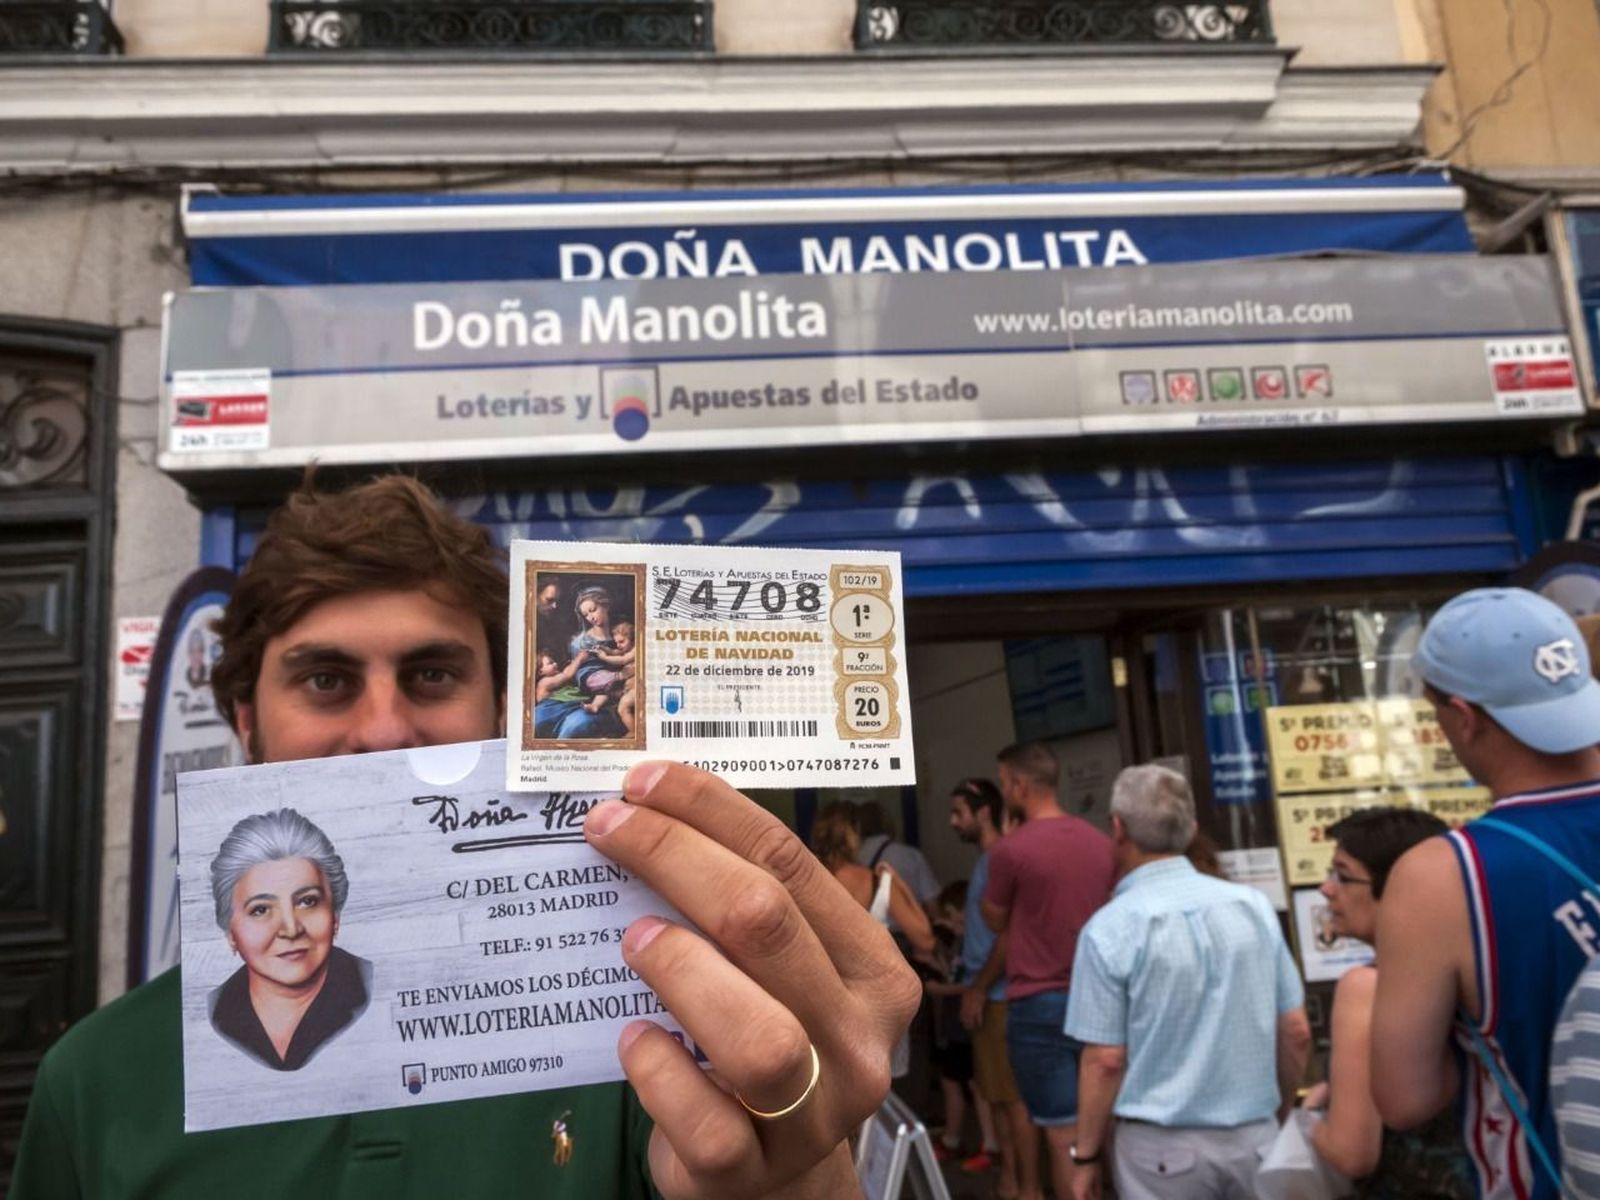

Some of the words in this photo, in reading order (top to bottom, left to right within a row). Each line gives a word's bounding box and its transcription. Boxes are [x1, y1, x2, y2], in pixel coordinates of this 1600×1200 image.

[558, 229, 760, 282] DOÑA
[800, 229, 1148, 275] MANOLITA
[413, 298, 562, 350] Doña
[580, 290, 827, 344] Manolita
[974, 300, 1353, 333] www.loteriamanolita.com
[437, 389, 566, 419] Loterías
[575, 395, 593, 420] y
[669, 383, 811, 416] Apuestas
[821, 378, 867, 405] del
[875, 376, 979, 404] Estado
[843, 575, 878, 586] 102/19
[654, 578, 822, 614] 74708
[655, 626, 730, 642] LOTERÍA
[735, 630, 823, 643] NACIONAL
[686, 648, 709, 660] DE
[714, 648, 795, 660] NAVIDAD
[846, 663, 883, 672] FRACCIÓN
[666, 664, 680, 676] 22
[684, 664, 700, 676] de
[703, 664, 765, 677] diciembre
[767, 665, 783, 677] de
[786, 665, 815, 677] 2019
[853, 686, 880, 694] PRECIO
[854, 697, 880, 717] 20
[446, 880, 468, 899] C/
[475, 875, 519, 896] DEL
[524, 863, 629, 891] CARMEN,
[488, 903, 536, 919] 28013
[540, 890, 620, 913] MADRID
[535, 937, 553, 952] 91
[558, 933, 587, 950] 522
[590, 931, 610, 946] 76
[396, 990, 422, 1008] TE
[425, 978, 525, 1005] ENVIAMOS
[529, 973, 563, 993] LOS
[430, 1062, 478, 1083] PUNTO
[480, 1057, 528, 1078] AMIGO
[529, 1054, 564, 1073] 97310
